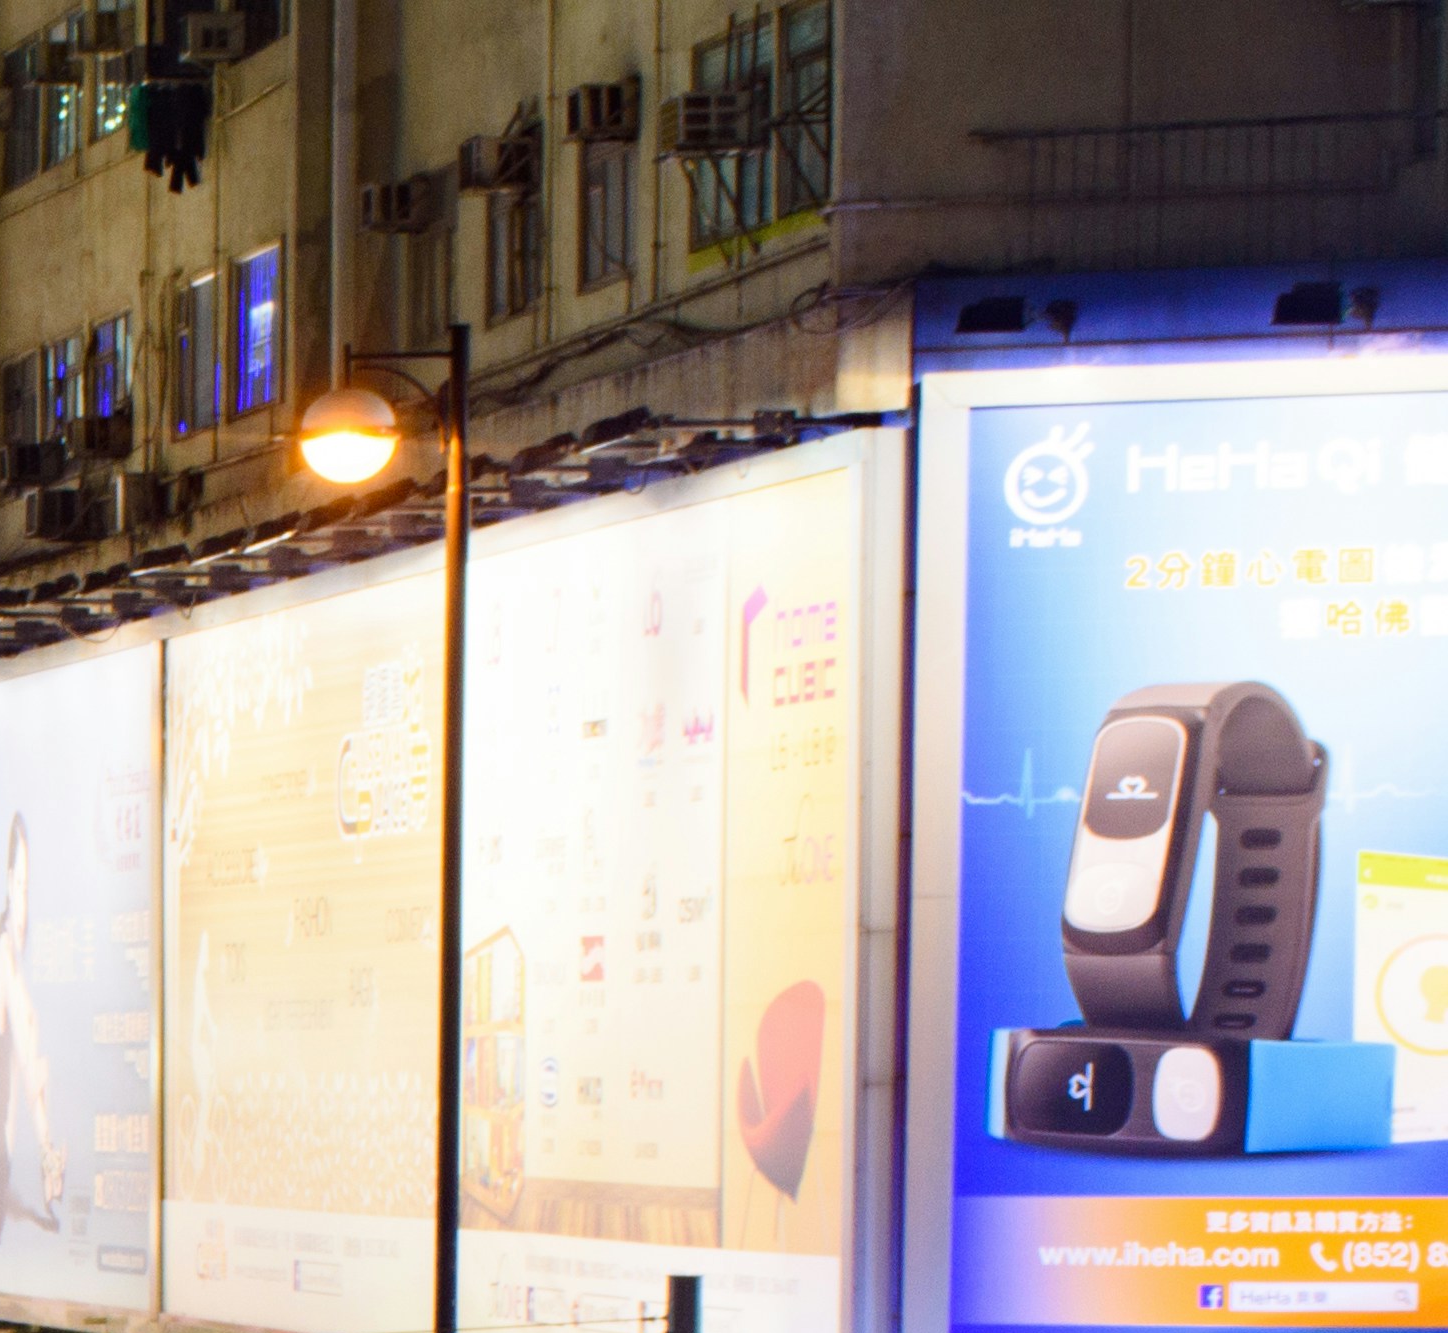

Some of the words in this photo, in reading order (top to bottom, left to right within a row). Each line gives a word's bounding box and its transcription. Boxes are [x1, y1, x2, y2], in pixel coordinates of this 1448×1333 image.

[1038, 1243, 1280, 1269] www.iheha.com
[1341, 1243, 1421, 1272] (852)
[1425, 1243, 1448, 1269] 8
